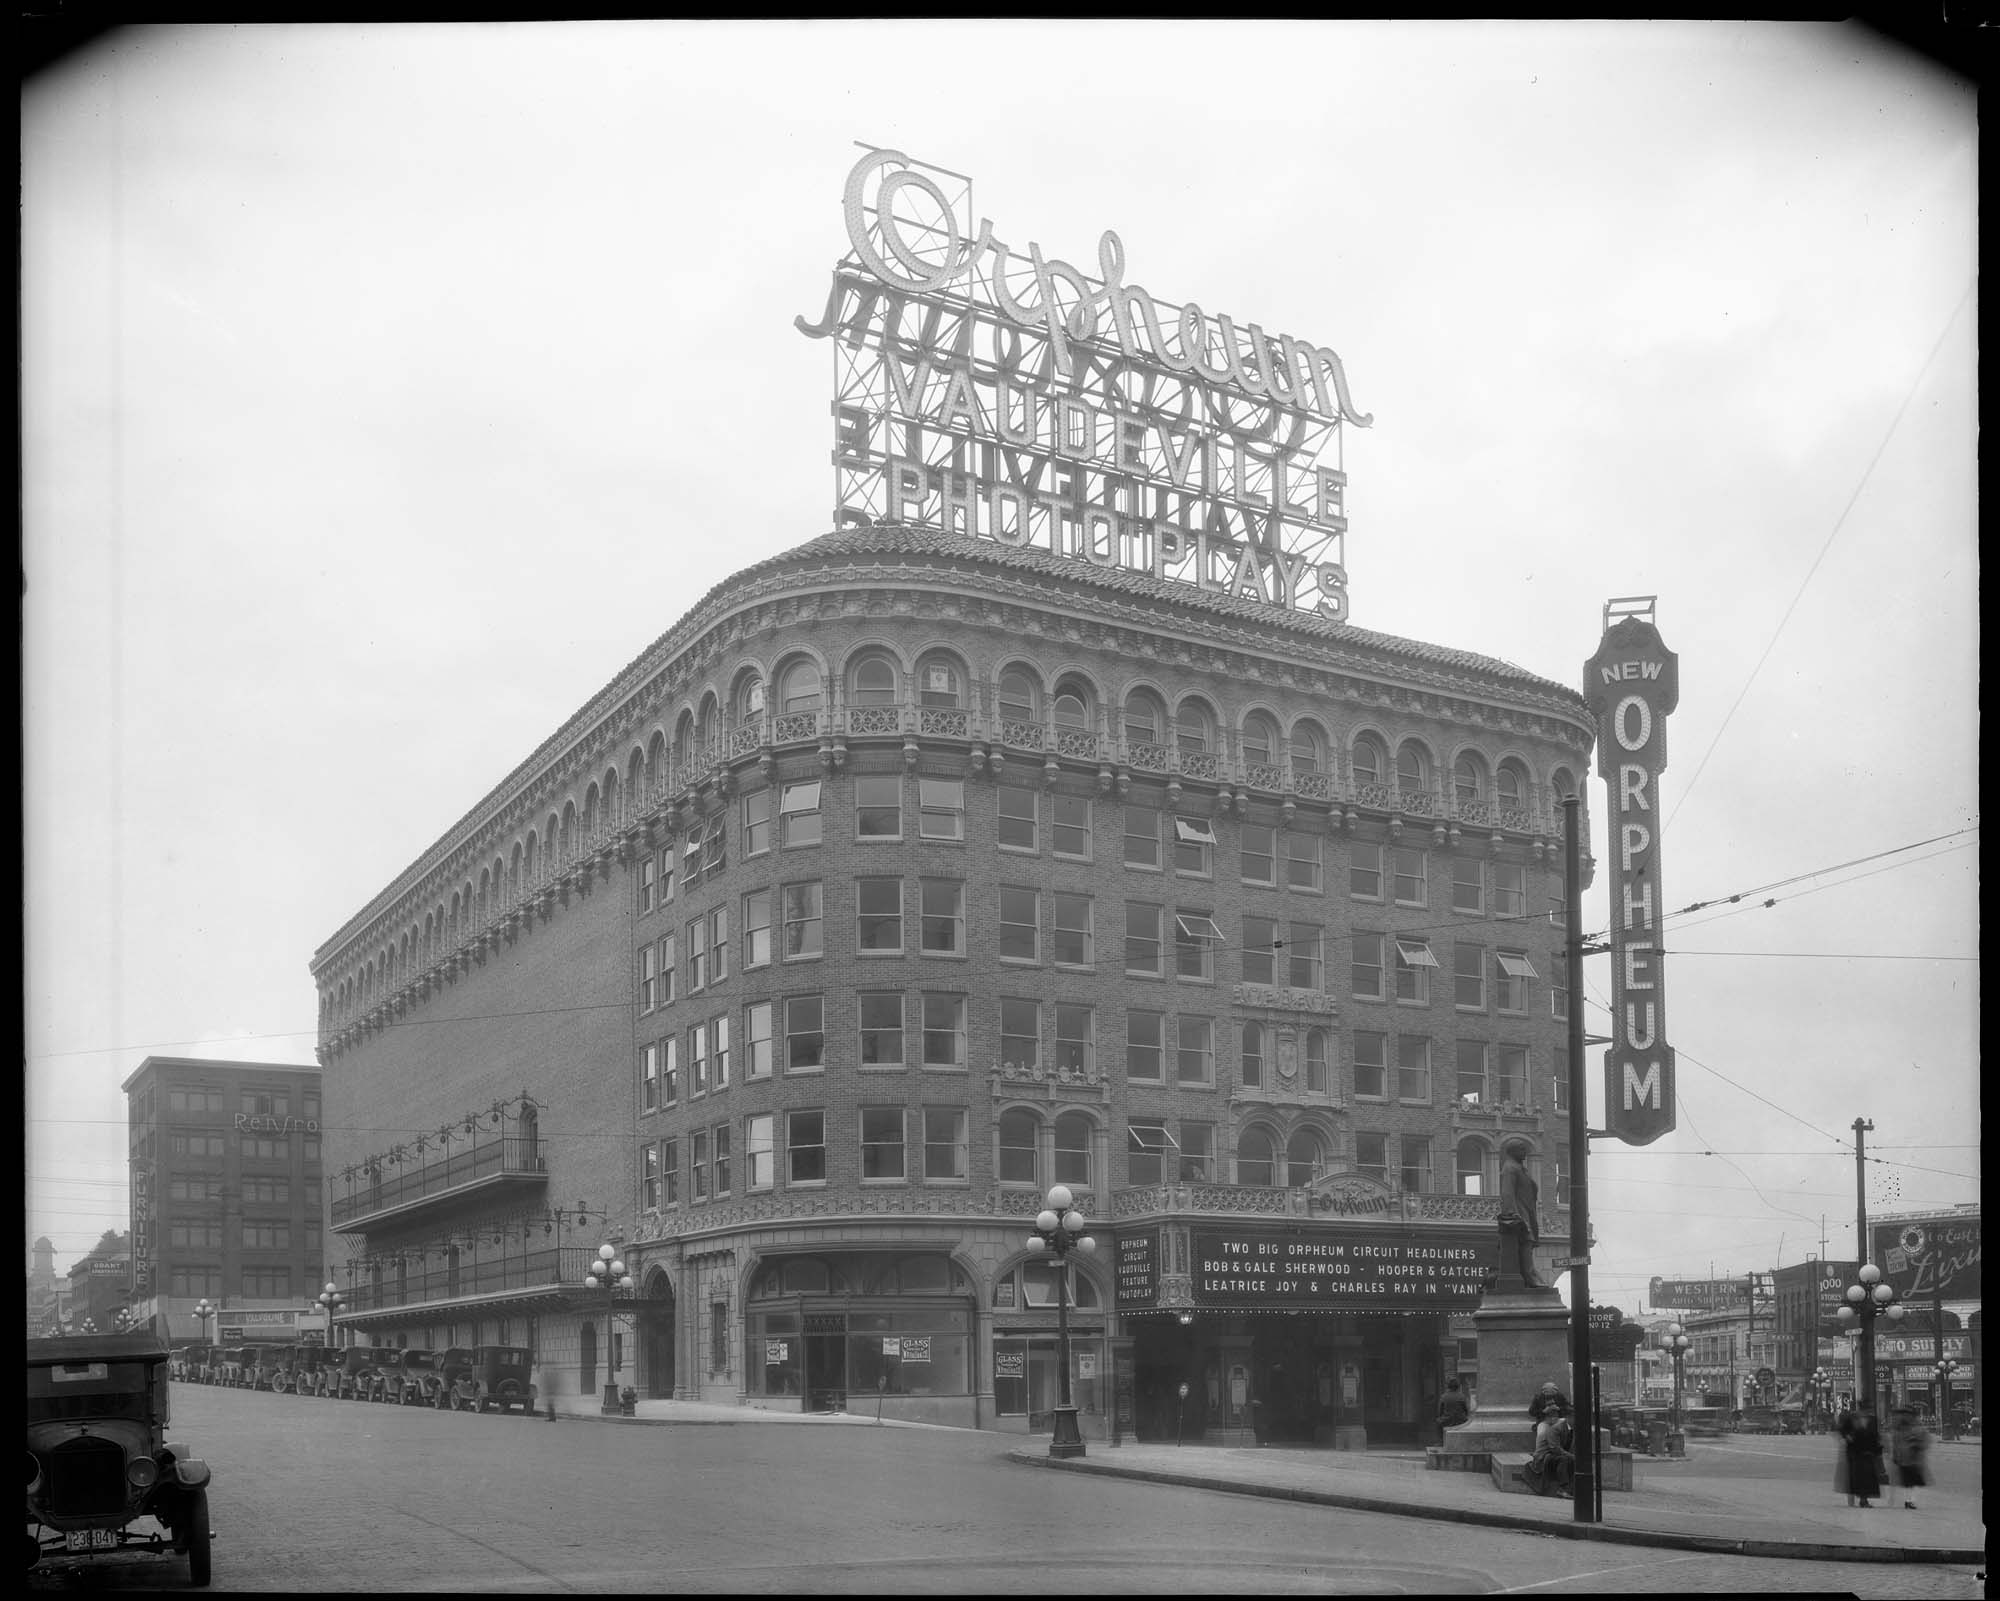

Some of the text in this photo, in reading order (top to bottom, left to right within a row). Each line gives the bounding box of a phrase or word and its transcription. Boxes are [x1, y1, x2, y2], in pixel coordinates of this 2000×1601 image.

[843, 148, 1374, 429] Orpheum
[885, 351, 1348, 532] VAUDEVILLE
[1601, 661, 1663, 685] NEW
[1613, 695, 1662, 1111] ORPHEUM
[136, 1171, 148, 1285] FURNITURE
[1121, 1239, 1149, 1250] ORPHEUM
[1223, 1242, 1476, 1260] TWO BIG ORPHEUM CIRCUIT HEADLINERS
[1204, 1260, 1228, 1272] BOB
[1232, 1261, 1240, 1273] &
[1244, 1262, 1276, 1273] GALE
[1285, 1262, 1351, 1275] SHERWOOD
[1378, 1264, 1423, 1276] HOOPER
[1428, 1265, 1436, 1277] &
[1122, 1276, 1148, 1286] FEATURE
[1205, 1279, 1266, 1292] LEATRICE
[1275, 1281, 1298, 1292] JOY
[1310, 1281, 1319, 1292] &
[1331, 1281, 1386, 1293] CHARLES
[1394, 1283, 1418, 1294] RAY
[1425, 1283, 1437, 1294] IN
[1820, 1278, 1842, 1292] 1000
[1674, 1283, 1738, 1295] WESTERN
[903, 1339, 929, 1349] GLASS
[1912, 1338, 1964, 1351] SUPLY
[998, 1355, 1022, 1364] GLASS
